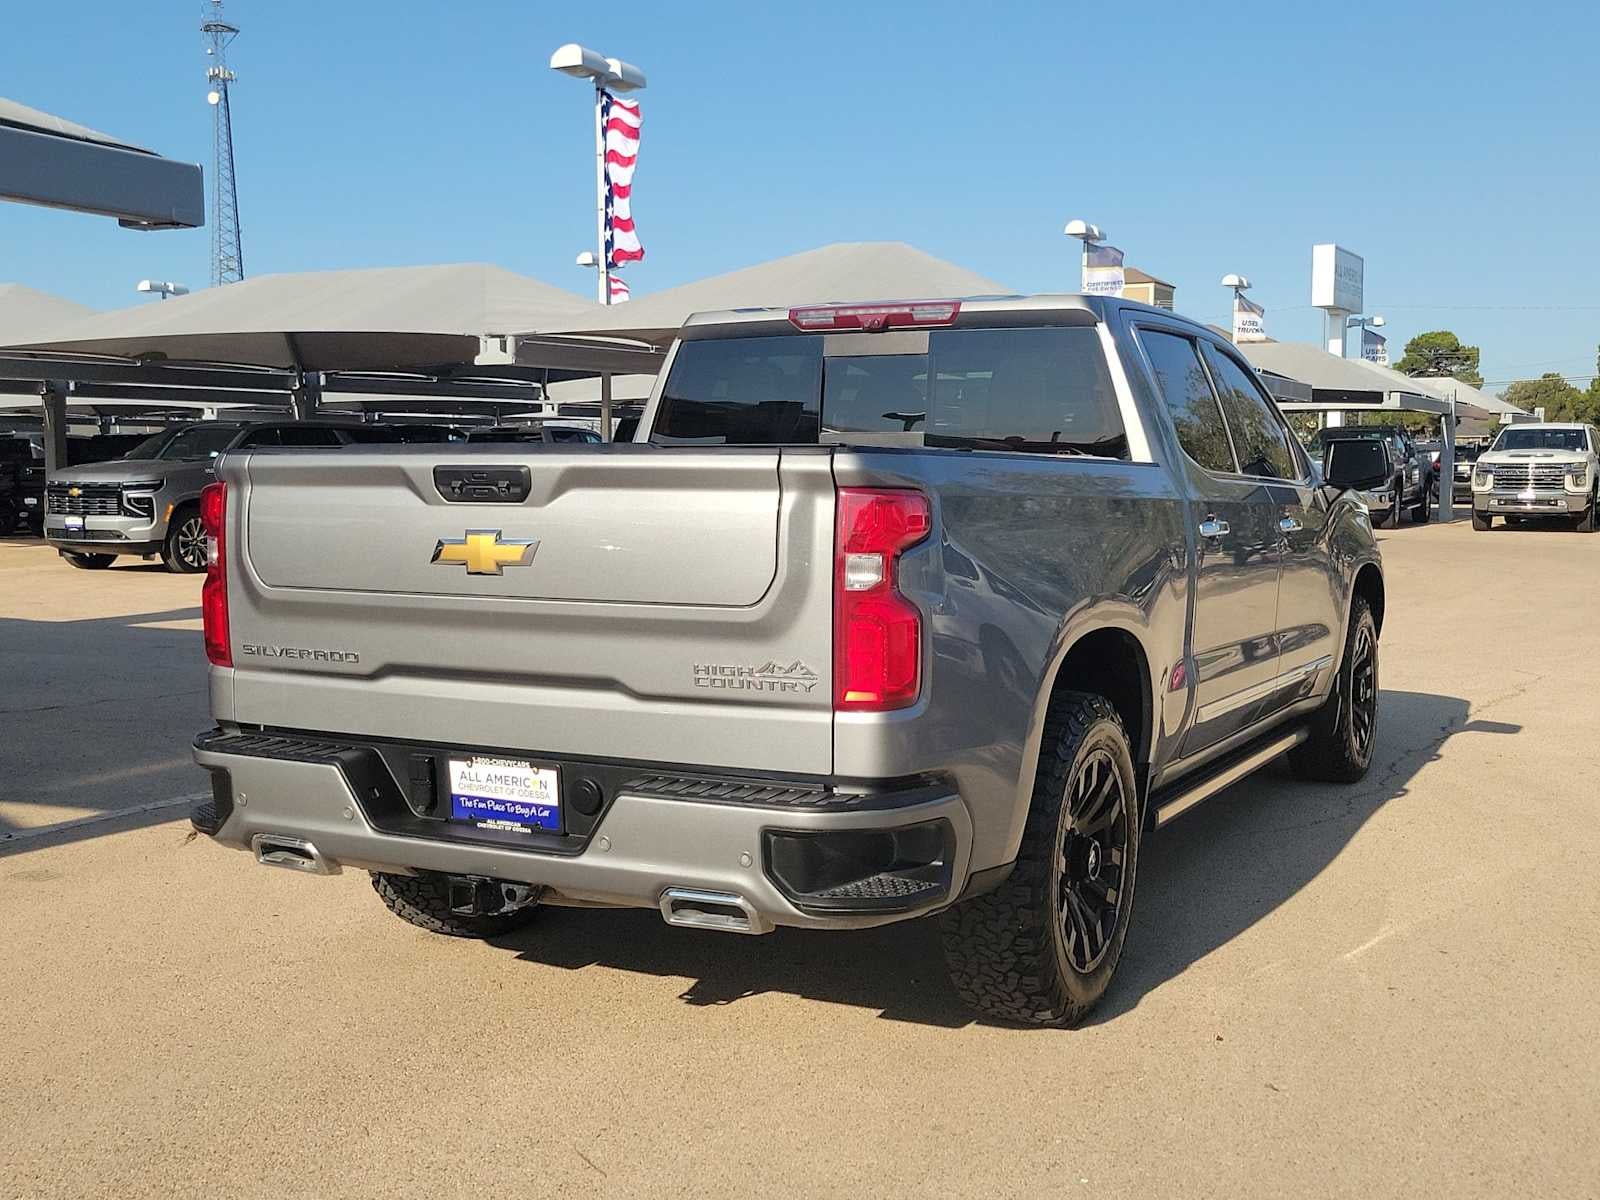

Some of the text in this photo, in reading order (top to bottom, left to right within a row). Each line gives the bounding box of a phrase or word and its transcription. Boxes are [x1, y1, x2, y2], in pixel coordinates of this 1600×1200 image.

[1365, 347, 1387, 355] USED
[242, 643, 360, 664] SILVERADO
[693, 663, 755, 678] HIGH
[693, 676, 817, 693] COUNTRY
[460, 770, 482, 783] ALL
[458, 783, 551, 801] CHEVROLET OF ODESSA
[460, 797, 551, 818] The Fun Place To Buy A Car
